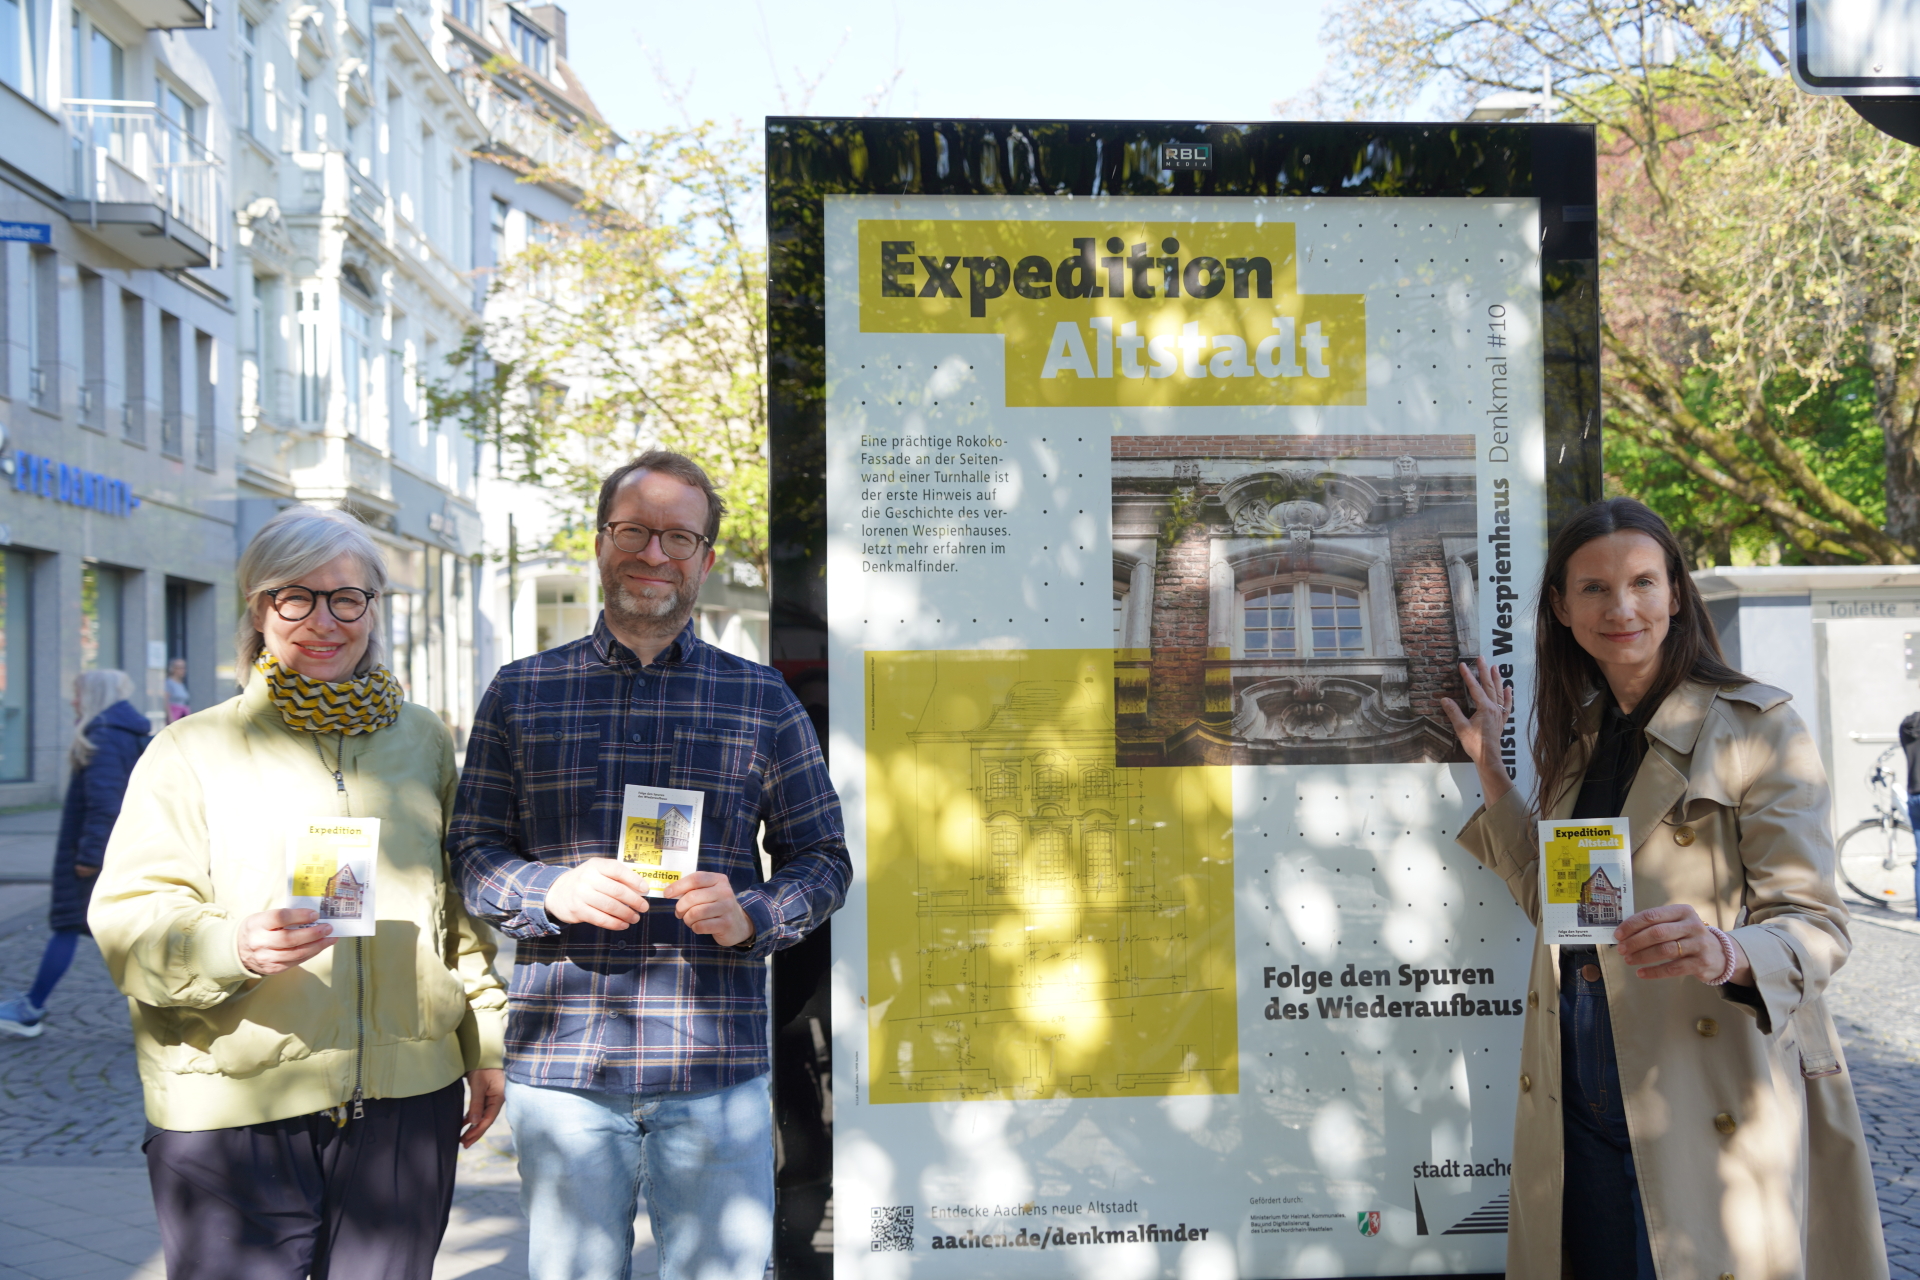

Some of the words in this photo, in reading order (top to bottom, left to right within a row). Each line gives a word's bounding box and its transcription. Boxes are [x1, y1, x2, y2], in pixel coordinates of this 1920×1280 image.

[1166, 148, 1207, 160] RBL
[881, 236, 1273, 317] Expedition
[1486, 304, 1507, 348] #10
[1041, 316, 1330, 379] Altstadt
[1486, 356, 1510, 464] Denkmal
[861, 435, 887, 447] Eine
[892, 435, 952, 450] prächtige
[957, 435, 1008, 447] Rokoko-
[861, 453, 911, 465] Fassade
[916, 455, 931, 465] an
[935, 453, 955, 465] der
[960, 453, 1004, 465] Seiten-
[861, 471, 895, 483] wand
[900, 471, 930, 483] einer
[934, 471, 991, 483] Turnhalle
[994, 471, 1009, 483] ist
[861, 489, 882, 501] der
[886, 490, 918, 501] erste
[923, 489, 972, 501] Hinweis
[976, 488, 997, 501] auf
[861, 507, 881, 519] die
[885, 507, 954, 519] Geschichte
[958, 507, 979, 519] des
[984, 509, 1008, 519] ver-
[862, 524, 908, 536] lorenen
[913, 524, 1011, 539] Wespienhauses.
[862, 543, 892, 555] Jetzt
[896, 543, 928, 554] mehr
[933, 542, 986, 554] erfahren
[991, 543, 1006, 554] im
[862, 560, 958, 572] Denkmalfinder.
[1488, 477, 1519, 657] Wespienhaus
[1828, 601, 1897, 618] Toilette
[309, 825, 362, 836] Expedition
[1556, 828, 1611, 839] Expedition
[1577, 838, 1619, 848] Altstadt
[633, 869, 679, 880] pedition
[1263, 965, 1333, 994] Folge
[1340, 964, 1391, 987] den
[1398, 964, 1495, 992] Spuren
[1264, 996, 1309, 1020] des
[1316, 993, 1523, 1020] Wiederaufbaus
[1413, 1159, 1460, 1178] stadt
[1463, 1158, 1511, 1177] aache
[1250, 1196, 1281, 1205] Gefördert
[1283, 1196, 1303, 1204] durch:
[931, 1205, 989, 1219] Entdecke
[993, 1203, 1047, 1217] Aachens
[1052, 1204, 1083, 1216] neue
[1087, 1200, 1139, 1214] Altstadt
[1273, 1220, 1310, 1228] Digitalisierung
[931, 1222, 1209, 1250] aachen.de/denkmalfinder
